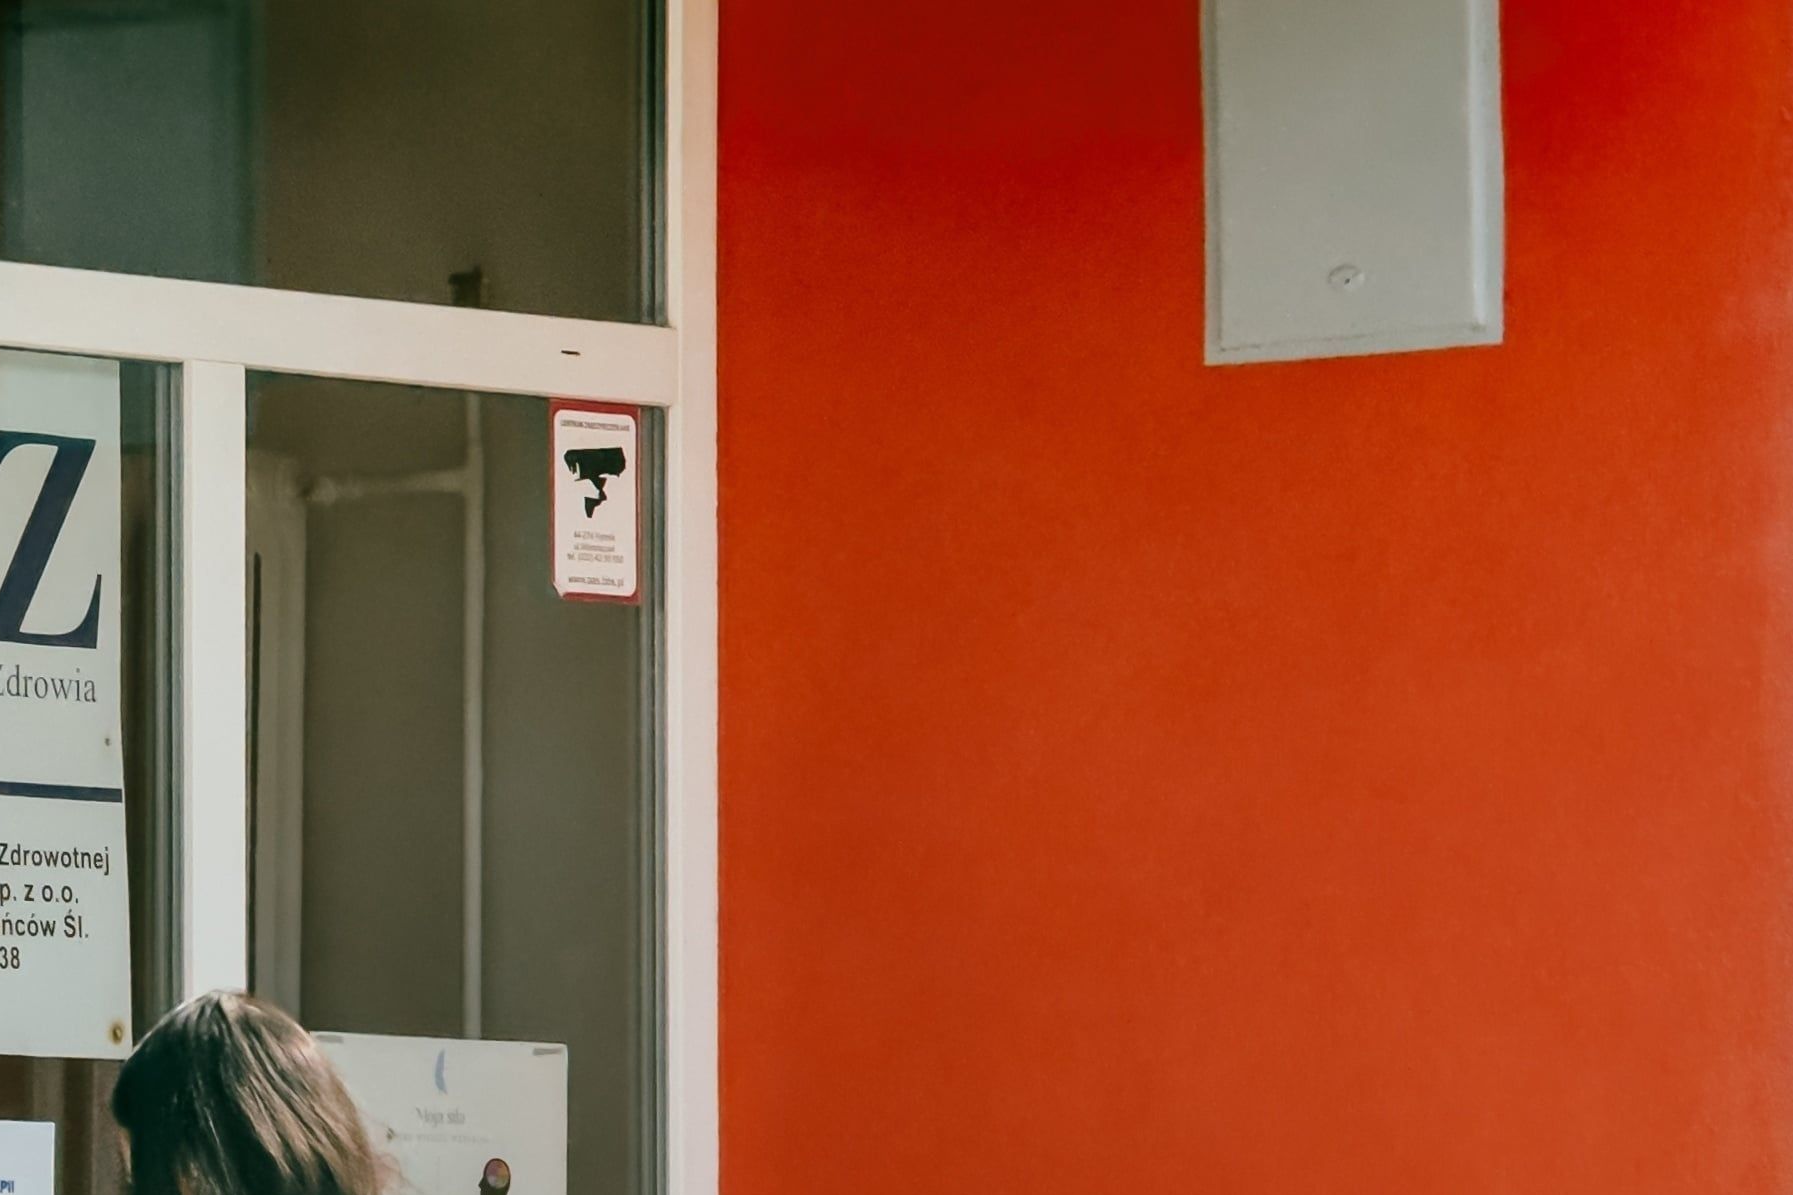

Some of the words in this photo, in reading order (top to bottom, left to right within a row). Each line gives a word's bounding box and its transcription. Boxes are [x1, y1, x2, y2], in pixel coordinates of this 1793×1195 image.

[23, 883, 35, 894] z
[41, 886, 79, 904] o.o.
[63, 908, 90, 939] Śl.
